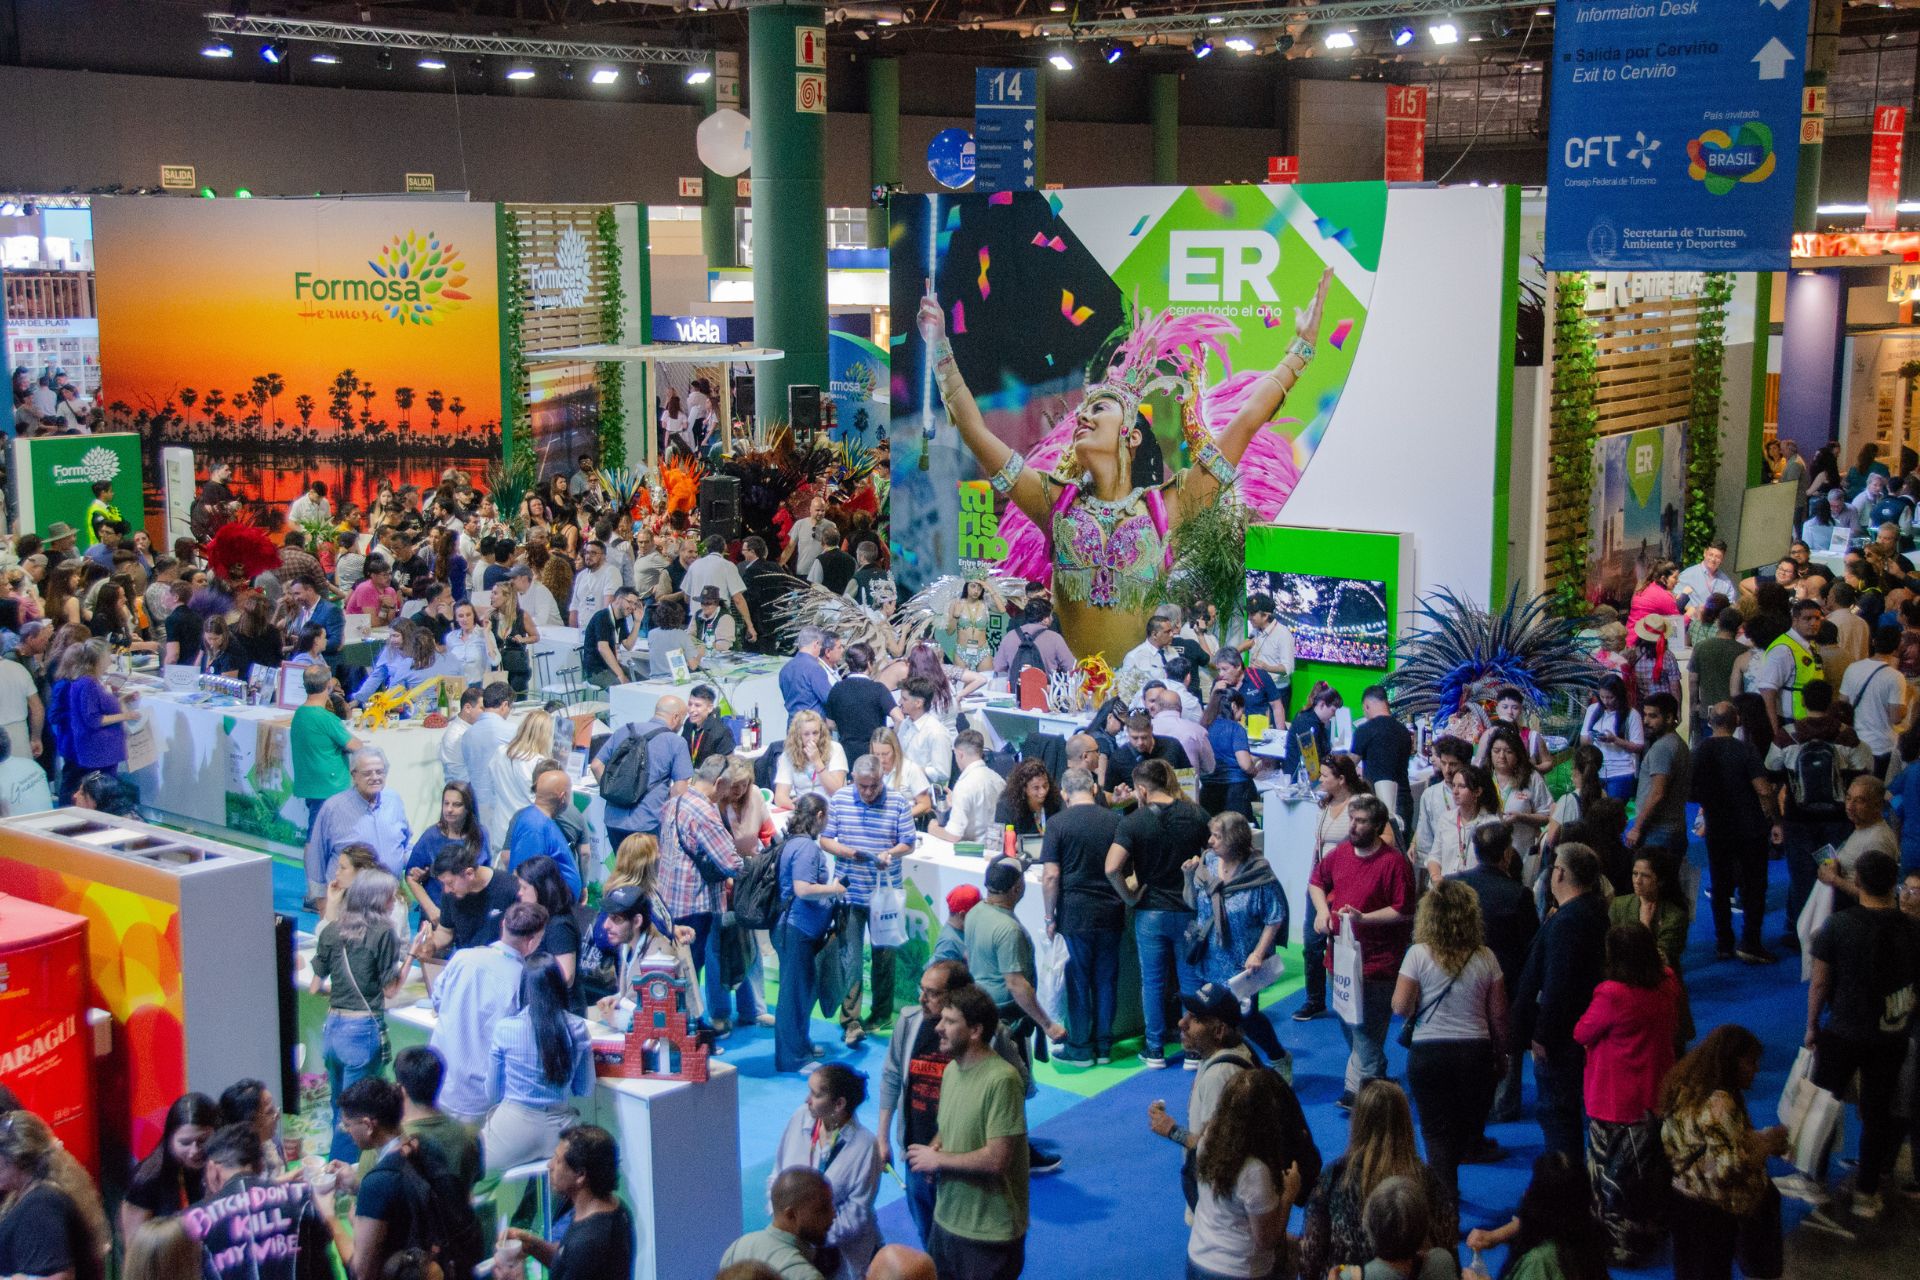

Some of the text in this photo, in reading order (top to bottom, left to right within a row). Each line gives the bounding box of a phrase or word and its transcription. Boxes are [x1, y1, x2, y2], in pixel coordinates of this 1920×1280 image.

[1576, 0, 1699, 23] Information Desk
[1576, 41, 1719, 63] Salida por Cerviño
[1572, 63, 1676, 83] Exit to Cerviño
[995, 71, 1022, 101] 14
[1397, 89, 1417, 114] 15
[1703, 110, 1760, 121] País invitado
[1881, 109, 1898, 130] 17
[1564, 135, 1622, 169] CFT
[1708, 151, 1756, 167] BRASIL
[164, 170, 193, 180] SALIDA
[1276, 158, 1288, 171] H
[408, 177, 432, 187] SALIDA
[1564, 176, 1657, 188] Consejo Federal de Turismo
[1680, 227, 1694, 239] de
[1697, 227, 1747, 239] Turismo,
[1622, 238, 1737, 252] Ambiente y Deportes
[531, 264, 577, 290] Formosa
[1169, 230, 1280, 302] ER
[295, 272, 421, 302] Formosa
[1632, 271, 1674, 298] ENTRE
[297, 300, 384, 328] Hermosa
[1207, 304, 1239, 317] todo
[1241, 304, 1253, 317] el
[676, 316, 720, 343] vuela
[830, 379, 861, 393] rmosa
[53, 464, 103, 477] Formosa
[1636, 445, 1653, 474] ER
[880, 912, 898, 921] FEST
[904, 907, 929, 940] R
[0, 1013, 77, 1077] ARAGUI
[183, 1181, 309, 1240] BITCH DON'T
[230, 1207, 292, 1241] KILL
[213, 1233, 302, 1272] MY VIBE
